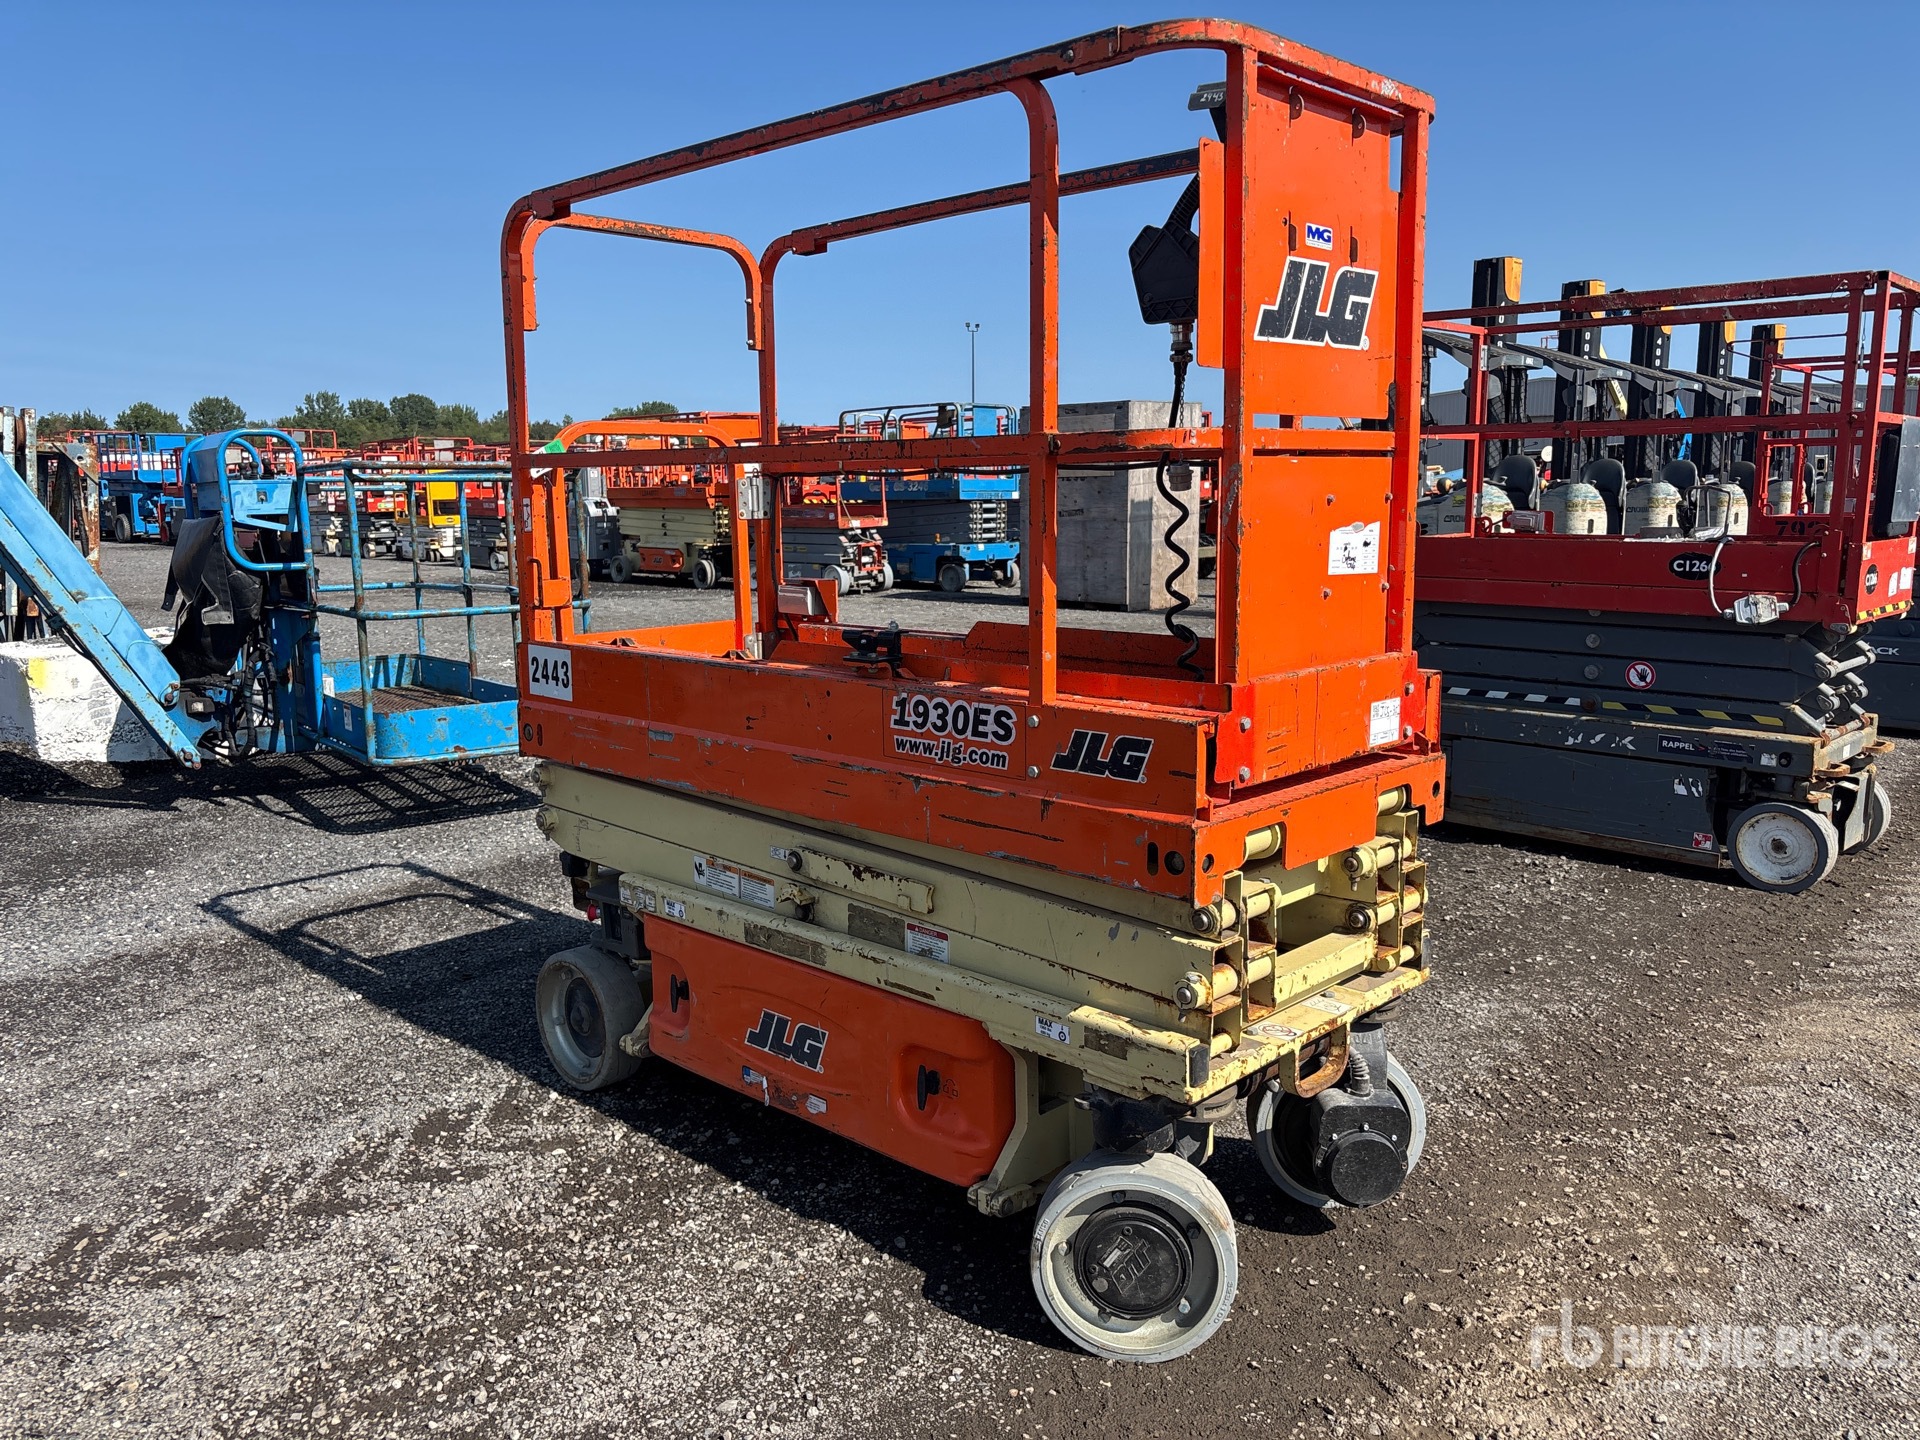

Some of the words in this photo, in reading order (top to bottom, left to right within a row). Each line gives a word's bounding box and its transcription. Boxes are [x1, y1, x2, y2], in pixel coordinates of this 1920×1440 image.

[1307, 225, 1331, 243] MG
[1254, 257, 1378, 349] JLG
[1444, 514, 1465, 523] CRO
[531, 656, 570, 688] 2443
[892, 693, 1017, 745] 1930ES
[894, 735, 1008, 770] www.jlg.com
[1050, 729, 1154, 783] JLG
[1662, 740, 1695, 751] RAPPEL
[1038, 1017, 1053, 1029] MAX
[745, 1008, 829, 1073] JLG
